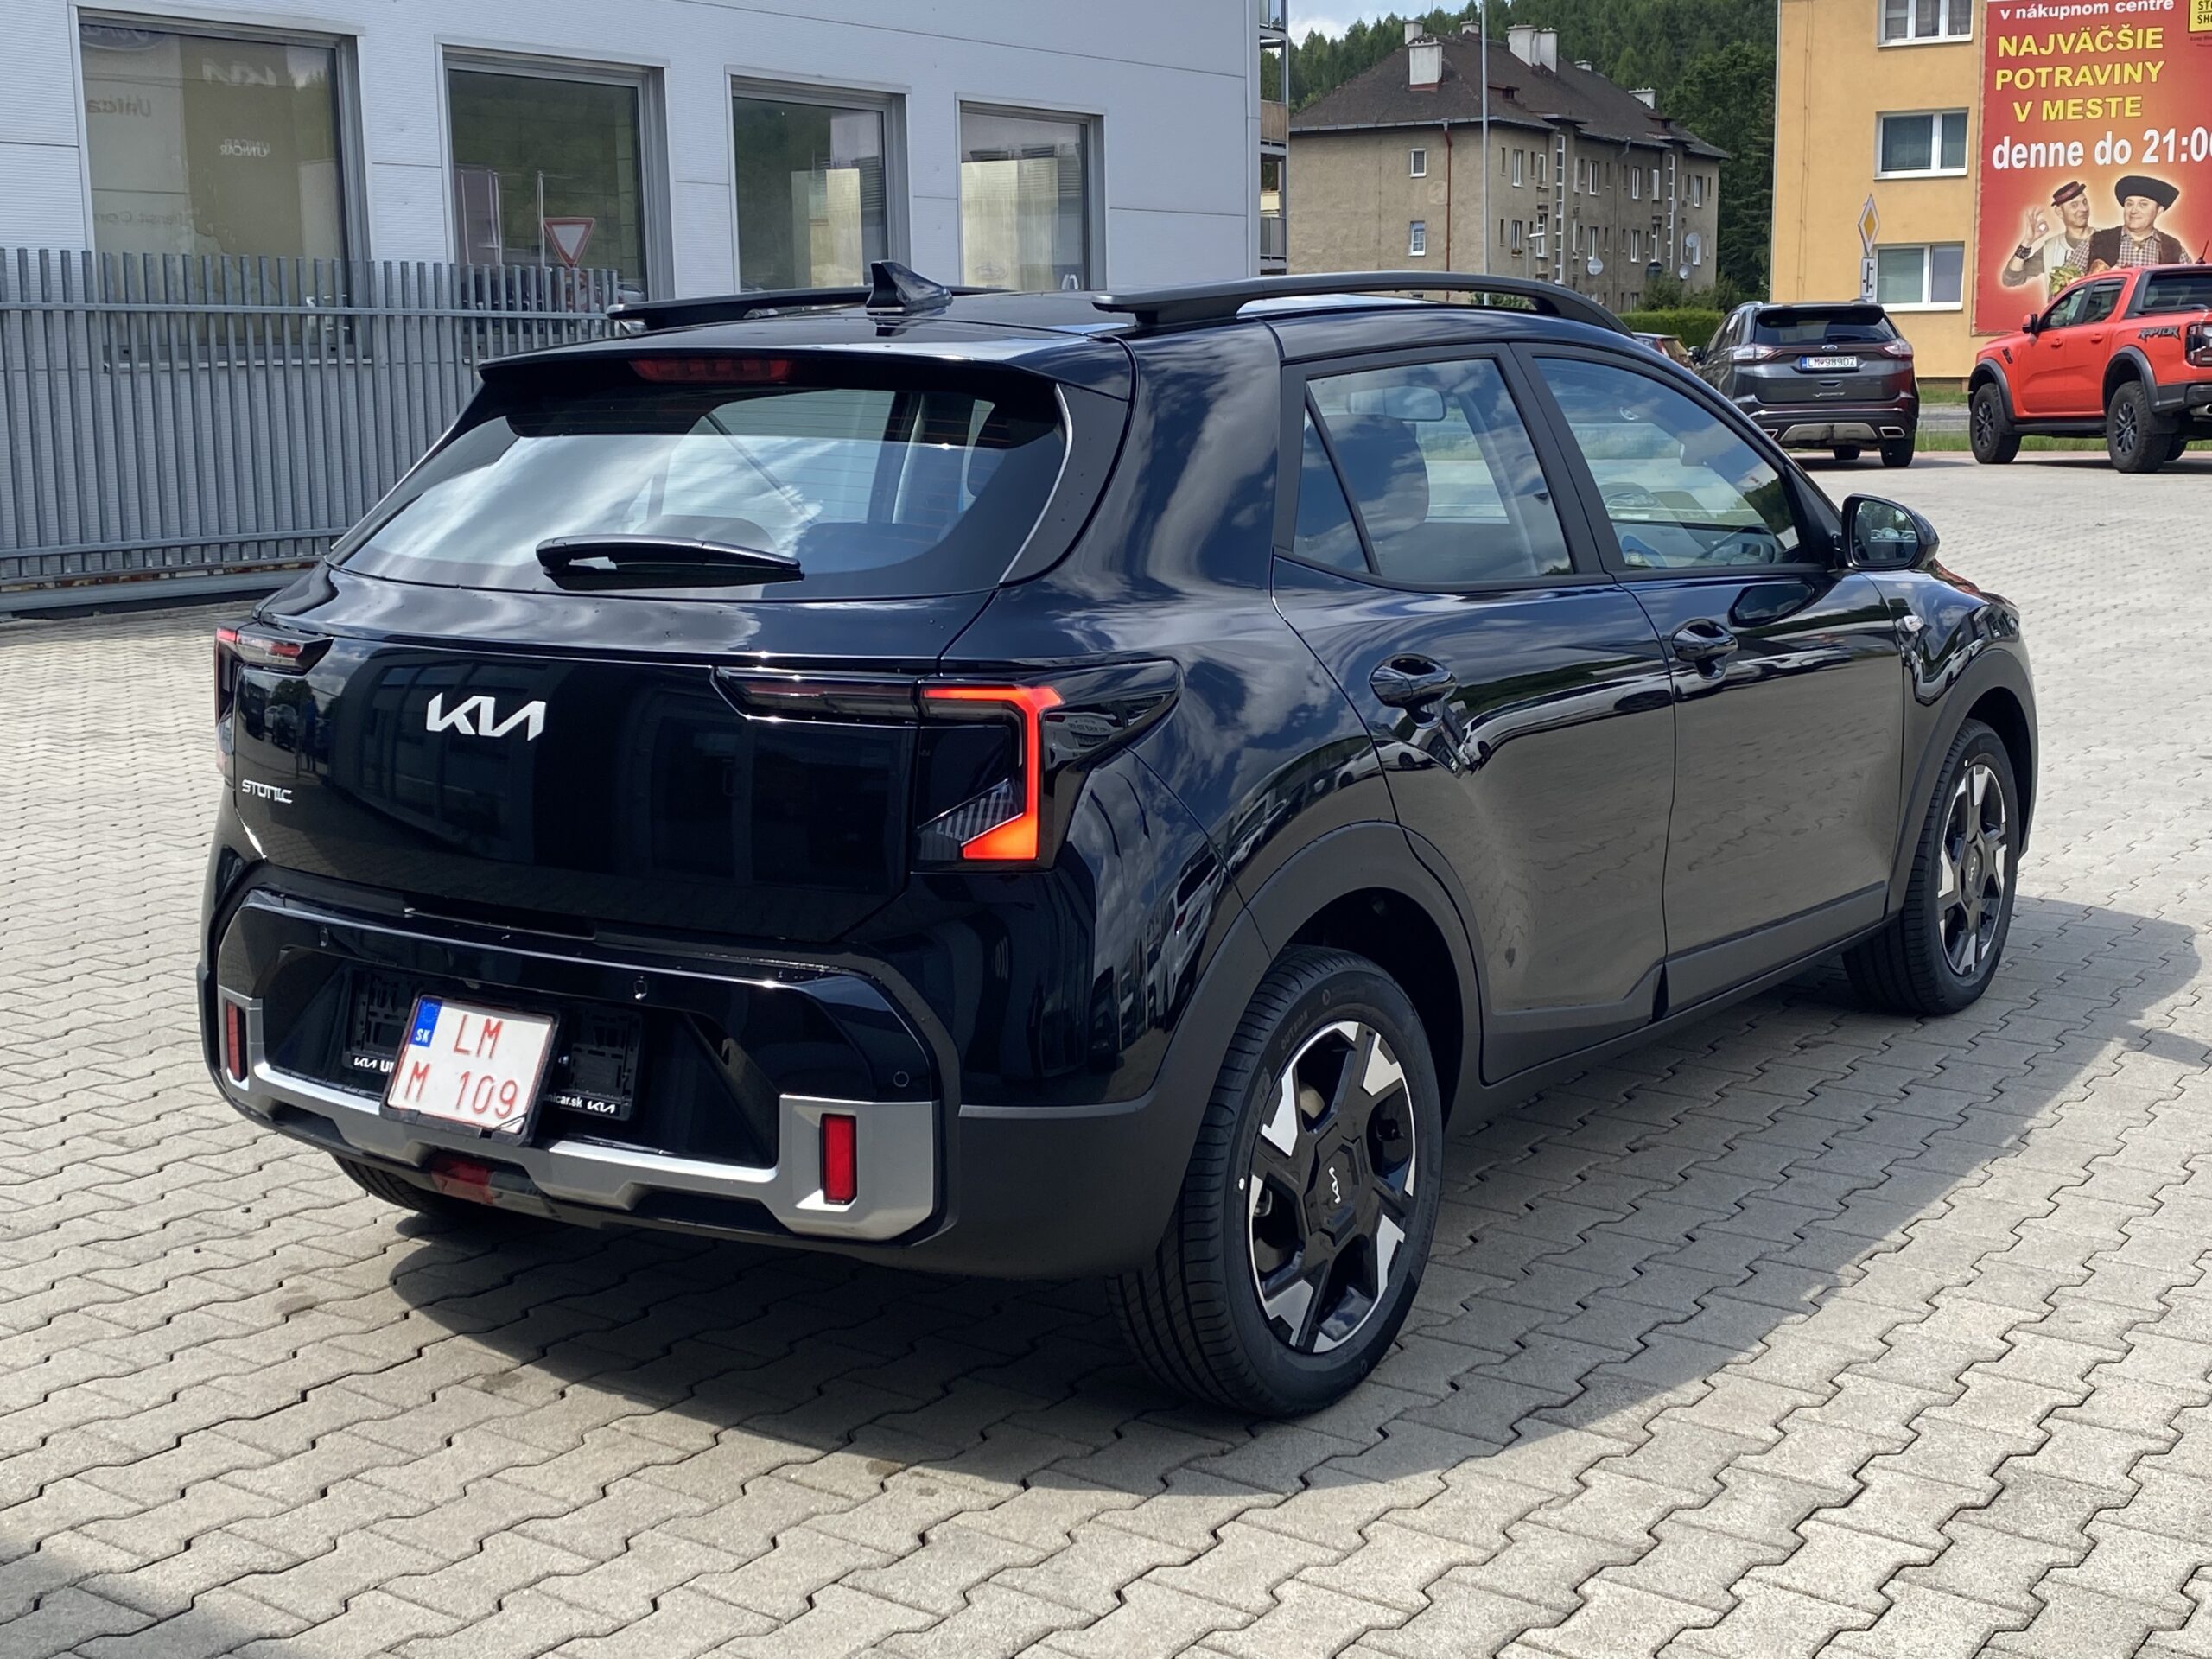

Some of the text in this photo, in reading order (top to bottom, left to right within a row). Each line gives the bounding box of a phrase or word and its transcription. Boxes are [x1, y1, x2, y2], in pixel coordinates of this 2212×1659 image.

[2000, 0, 2174, 21] v nákupnom centre
[2196, 14, 2212, 24] SH
[2197, 0, 2212, 10] ST
[1998, 23, 2164, 58] NAJVÄČŠIE
[1995, 60, 2165, 91] POTRAVINY
[2012, 96, 2142, 123] V MESTE
[1993, 126, 2212, 170] denne do 21:0
[426, 692, 547, 742] KIA
[241, 779, 294, 804] STONIC
[415, 1028, 432, 1044] SK
[453, 1014, 504, 1058] LM
[404, 1061, 519, 1119] M 109
